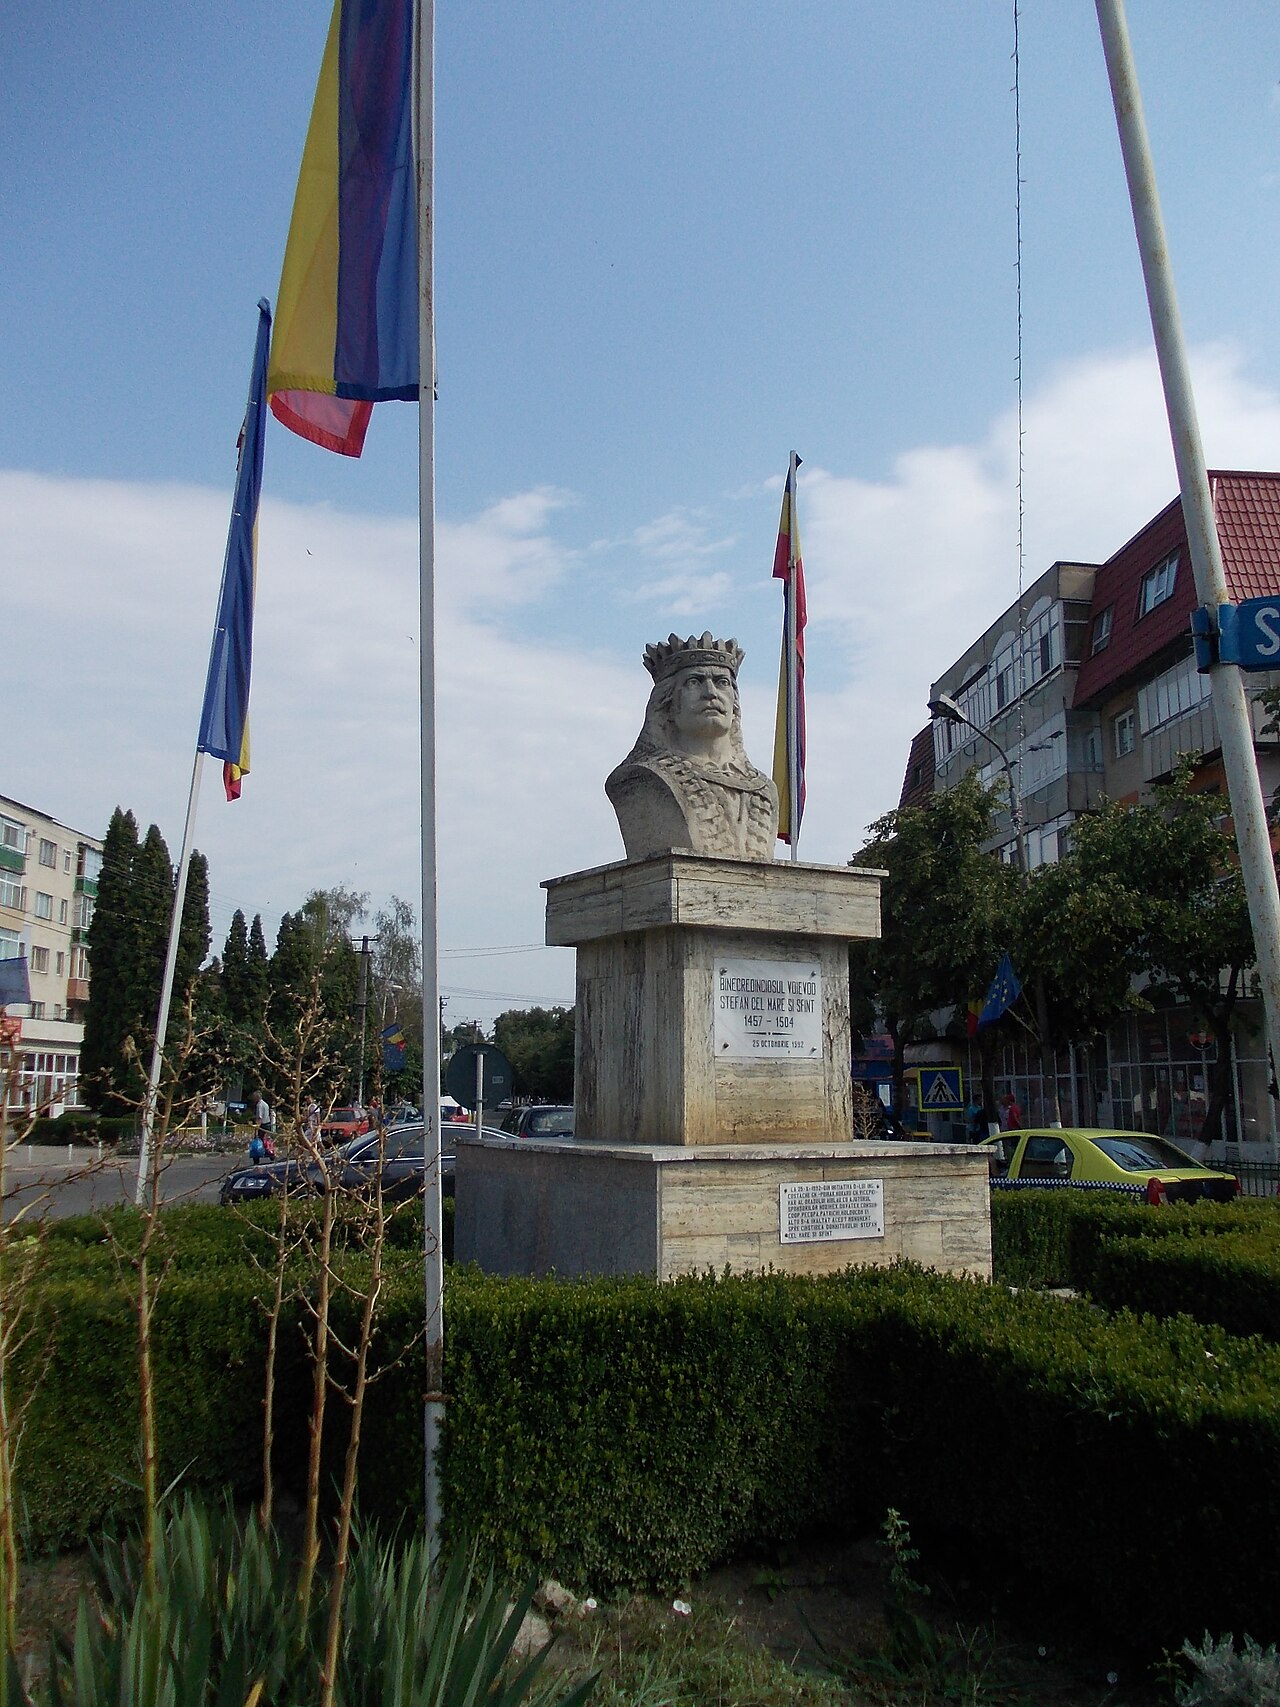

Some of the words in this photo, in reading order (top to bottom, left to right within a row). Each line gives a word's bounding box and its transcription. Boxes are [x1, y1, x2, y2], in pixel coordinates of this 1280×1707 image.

[720, 978, 785, 994] BINECREDINCIOSUL
[788, 981, 816, 996] VOIEVOD
[720, 996, 748, 1010] STEFAN
[752, 997, 764, 1010] CEL
[768, 998, 785, 1012] MARE
[788, 999, 794, 1012] SI
[744, 1016, 762, 1026] 1457
[776, 1016, 794, 1028] 1504
